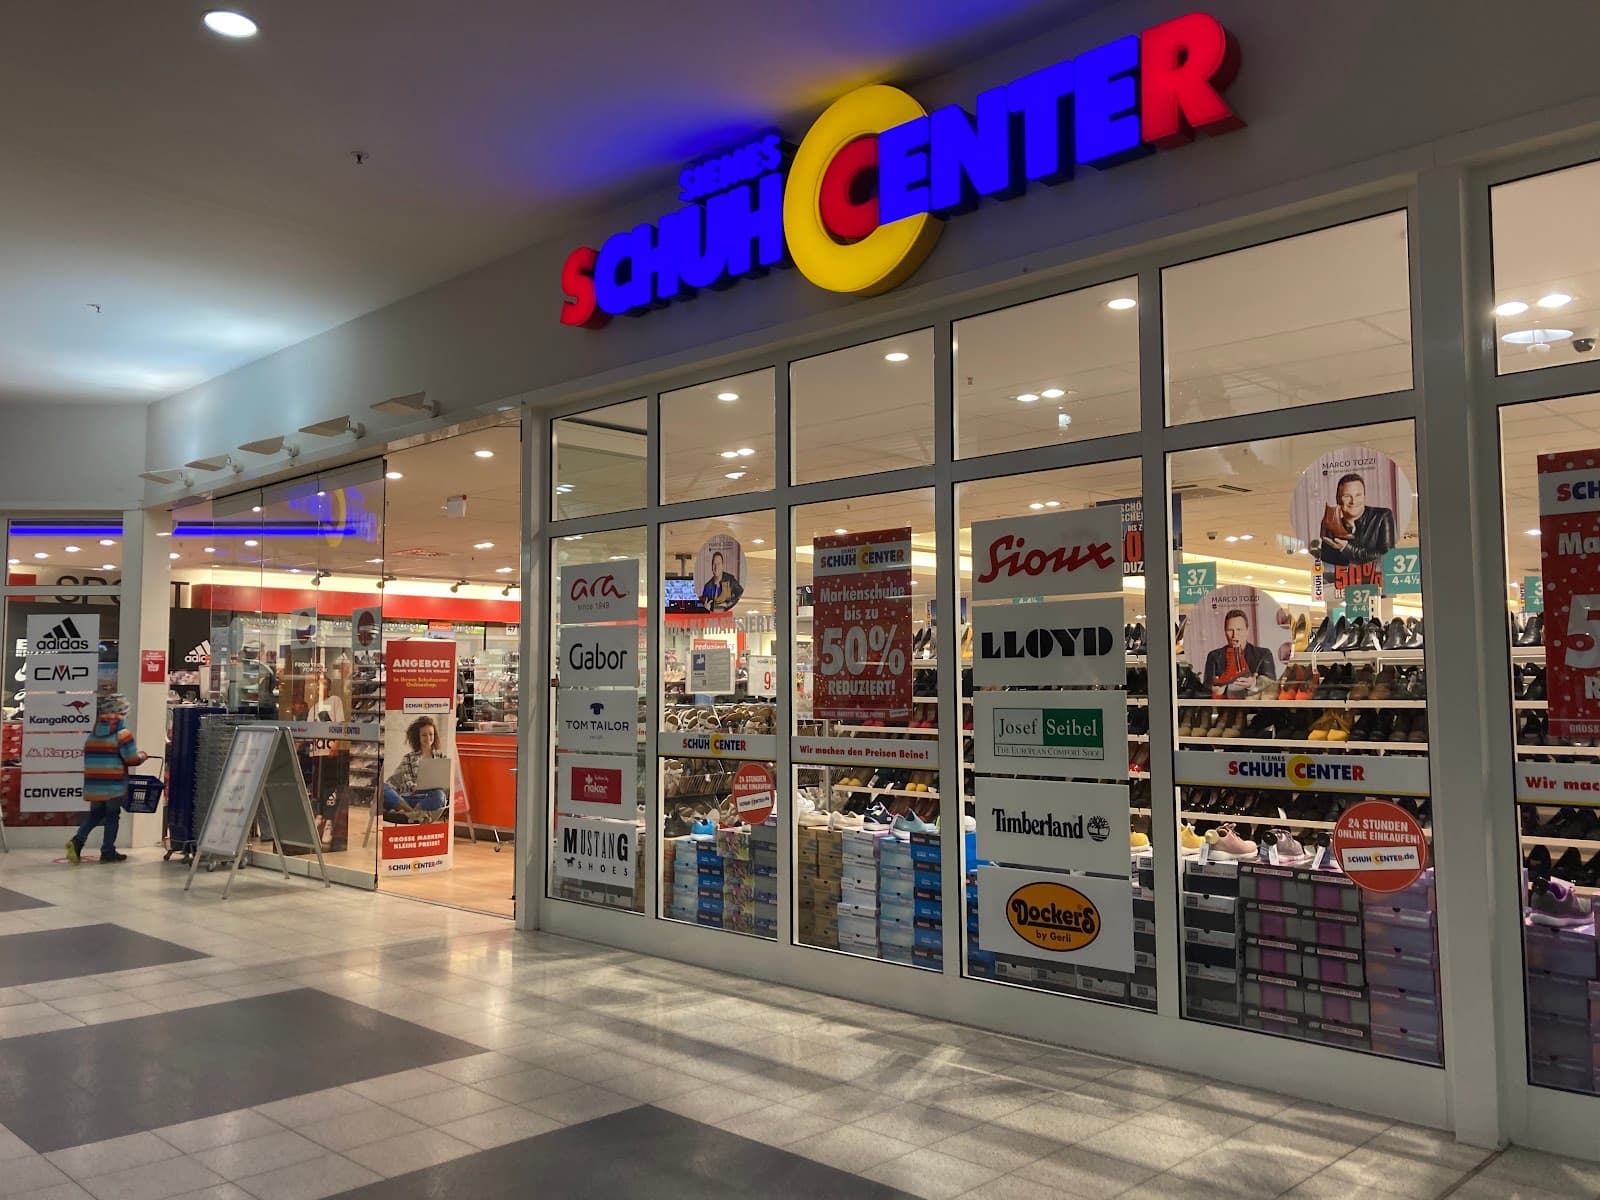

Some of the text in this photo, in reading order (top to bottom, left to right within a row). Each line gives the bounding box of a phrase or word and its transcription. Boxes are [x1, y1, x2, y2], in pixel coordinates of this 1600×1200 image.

[561, 12, 1242, 326] SCHUH CENTER
[1322, 457, 1377, 471] MARCO TOZZI
[821, 554, 857, 569] SCHUH
[977, 534, 1116, 583] Sioux
[1394, 555, 1418, 574] 37
[1187, 569, 1207, 586] 37
[55, 575, 190, 607] SPT
[571, 574, 627, 601] ara
[820, 583, 905, 603] Markenschuhe
[1211, 597, 1238, 605] MARCO
[1353, 589, 1370, 604] 37
[844, 605, 879, 621] bis zu
[37, 638, 89, 651] adidas
[821, 623, 905, 676] 50%
[981, 626, 1114, 659] LLOYD
[393, 659, 451, 669] ANGEBOTE
[569, 642, 629, 671] Gabor
[35, 665, 89, 681] CMP
[828, 679, 897, 696] REDUZIERT!
[29, 714, 90, 727] KangaROOS
[566, 720, 630, 732] TOM TAILOR
[998, 718, 1099, 738] Josef Seibel
[682, 735, 748, 753] SCHUH CENTER
[799, 744, 929, 761] Wir machen den Preisen Beine!
[44, 747, 84, 760] Kapp
[1228, 758, 1367, 784] SCHUH CENTER
[1524, 776, 1557, 790] Wir
[992, 807, 1085, 840] Timberland
[1348, 818, 1409, 833] 24 STUNDEN
[1337, 829, 1368, 840] ONLINE
[563, 827, 629, 862] MUSTANG
[1347, 852, 1415, 865] SCHUH CENTER.de
[388, 863, 411, 872] SCHUH
[577, 859, 629, 877] SHOES
[1035, 928, 1072, 945] by Gerli
